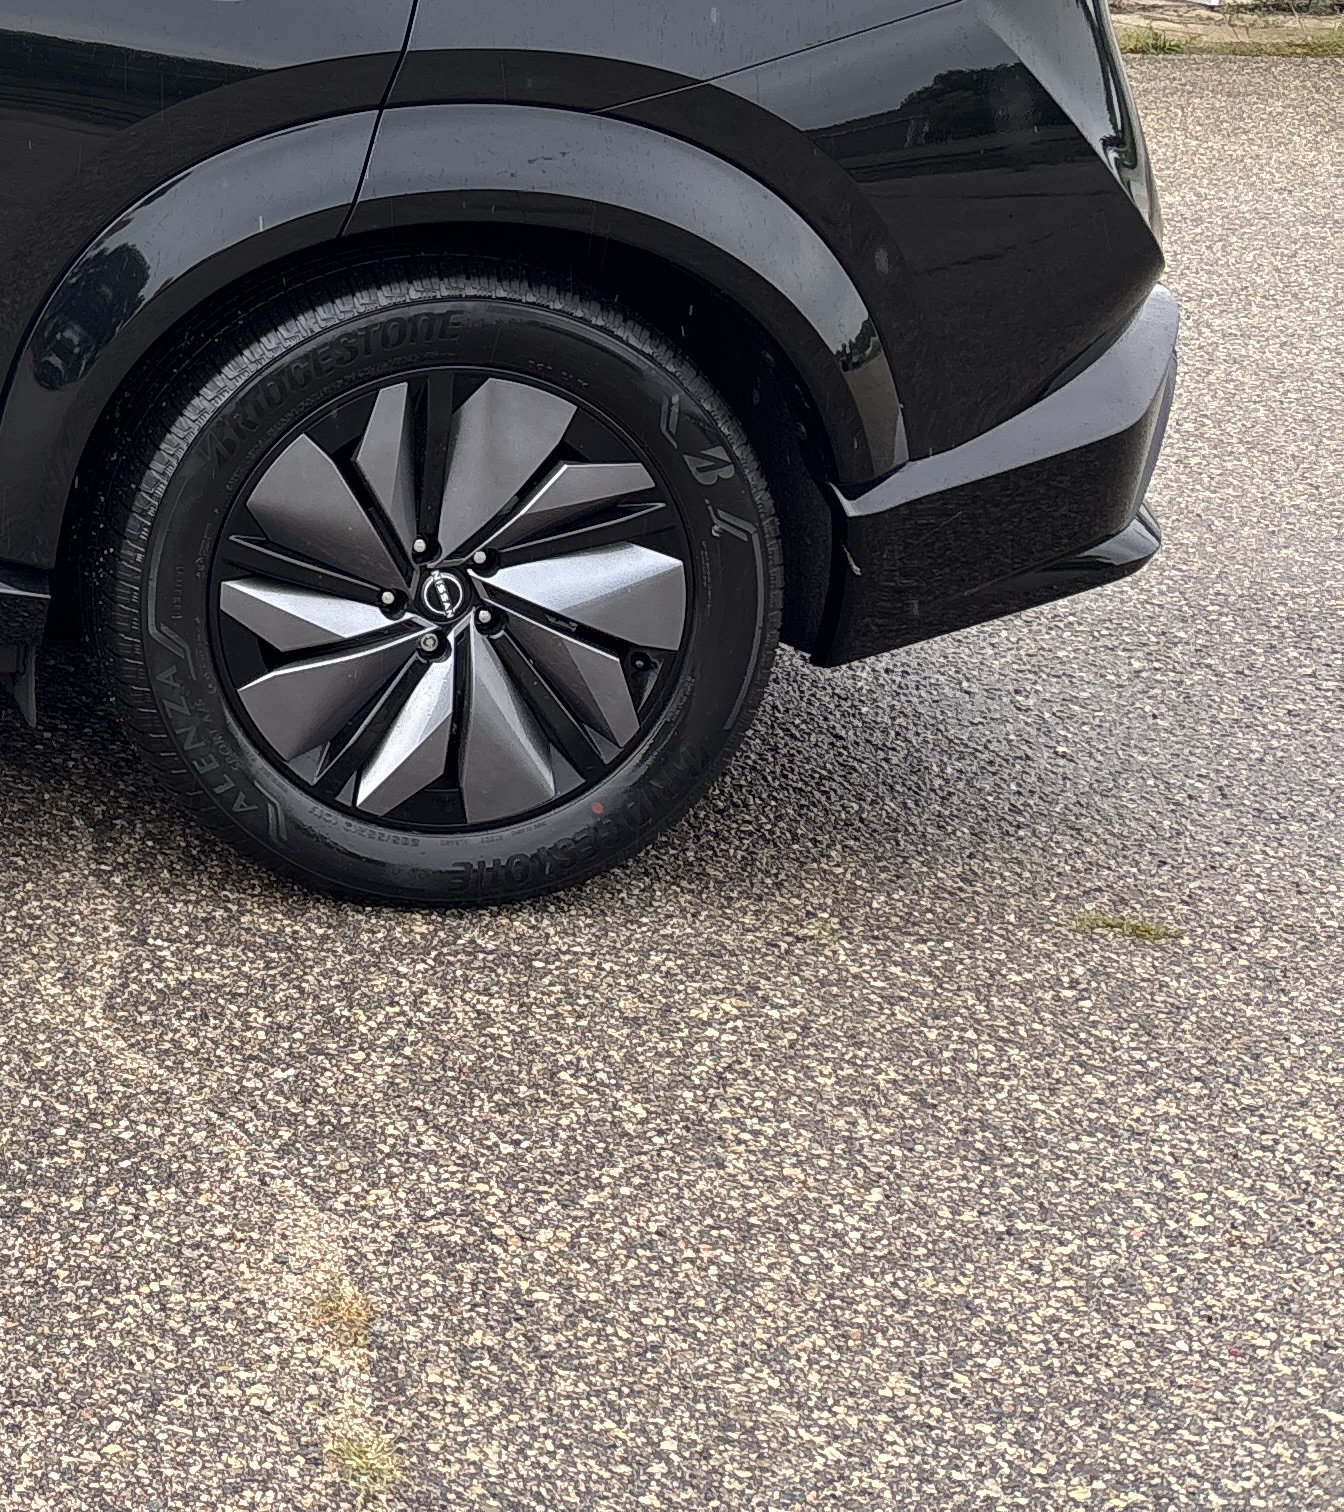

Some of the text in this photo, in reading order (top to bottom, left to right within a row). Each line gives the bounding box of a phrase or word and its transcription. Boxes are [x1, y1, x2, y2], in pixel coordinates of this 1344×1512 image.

[198, 309, 465, 478] BRIDGESTONE
[430, 569, 455, 619] NISSAN
[156, 664, 259, 813] ALENZA
